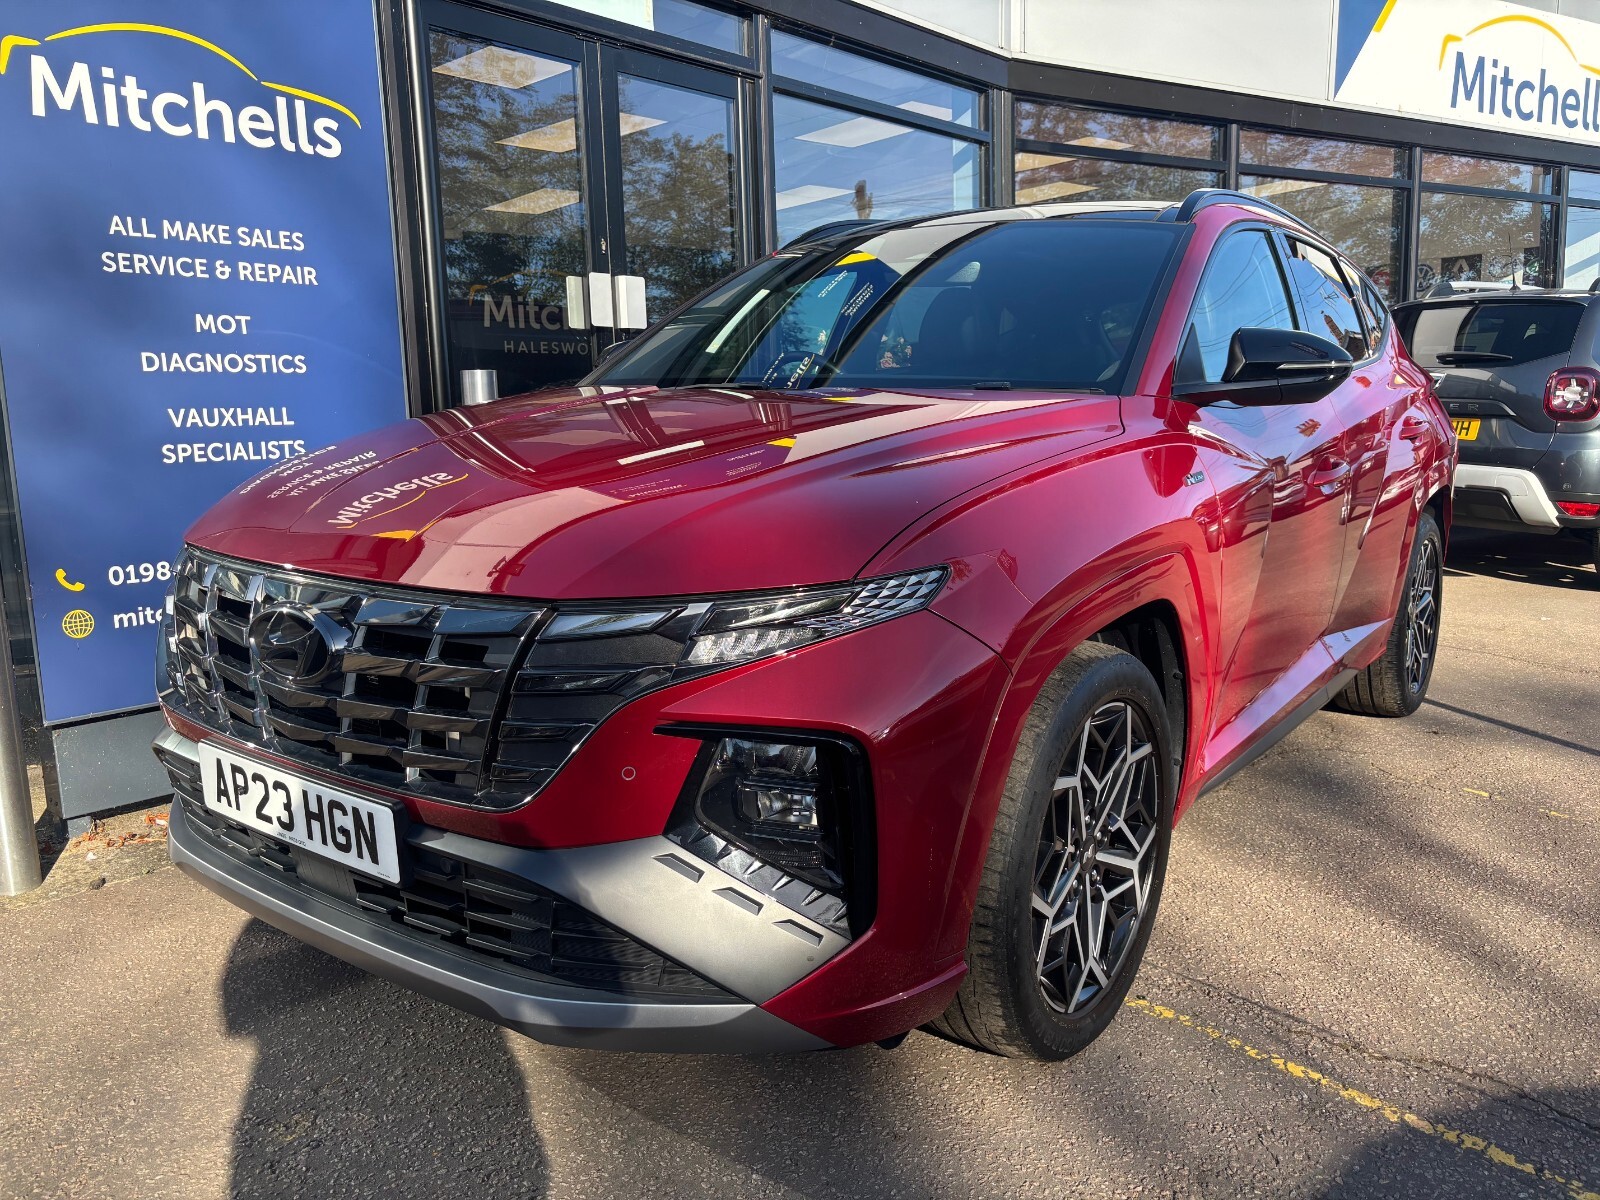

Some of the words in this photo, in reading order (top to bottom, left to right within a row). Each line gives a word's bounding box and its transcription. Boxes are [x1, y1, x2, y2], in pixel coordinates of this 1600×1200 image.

[30, 54, 342, 158] Mitchells
[1450, 51, 1600, 132] Mitchell
[109, 215, 156, 239] ALL
[163, 219, 232, 246] MAKE
[237, 227, 305, 251] SALES
[101, 251, 209, 279] SERVICE
[215, 263, 232, 280] &
[239, 264, 318, 286] REPAIR
[195, 314, 251, 334] MOT
[483, 294, 569, 330] Mitc
[140, 352, 307, 374] DIAGNOSTICS
[168, 407, 294, 428] VAUXHALL
[162, 440, 306, 464] SPECIALISTS
[216, 757, 295, 832] AP23
[302, 788, 380, 866] HGN
